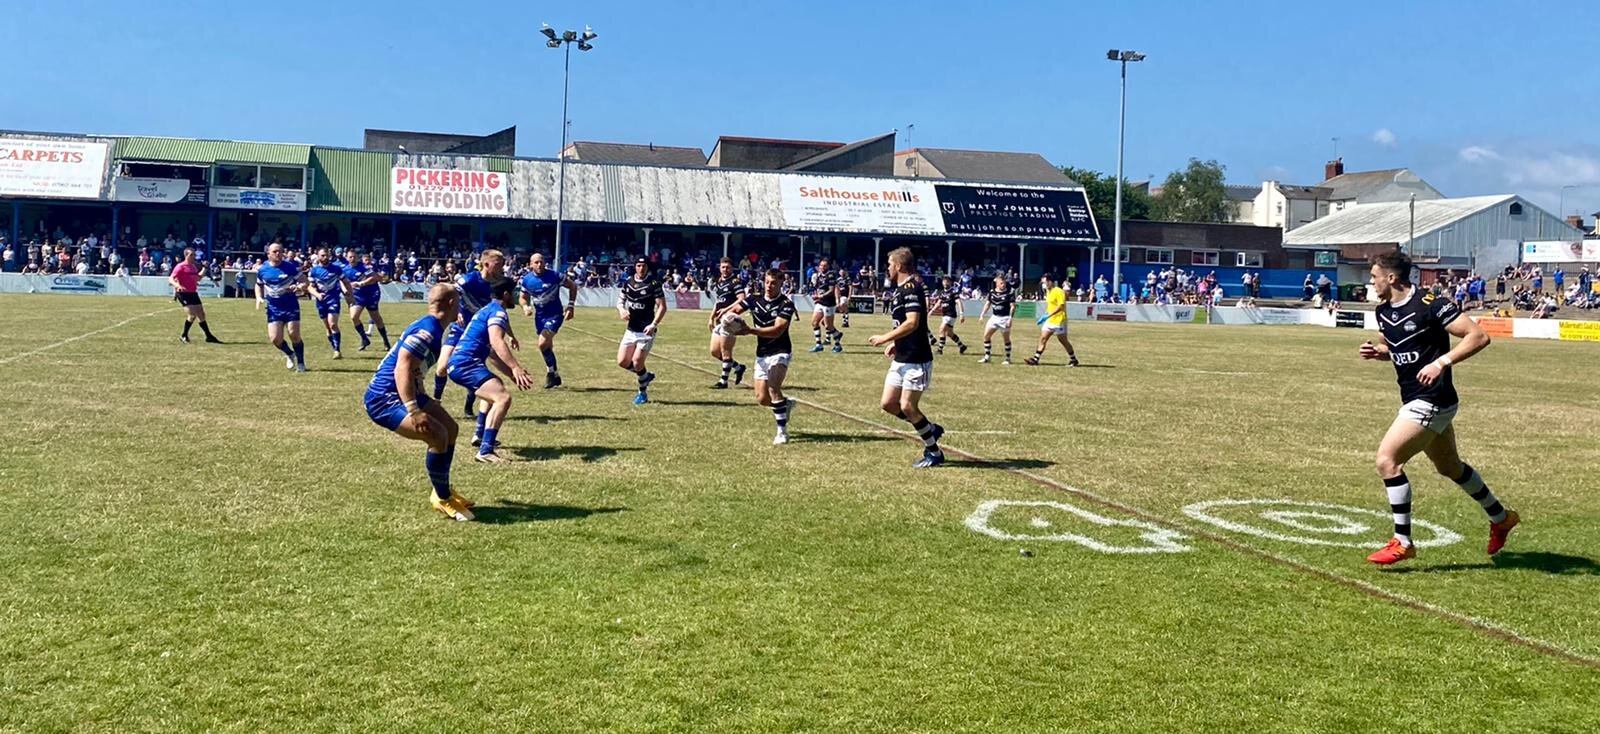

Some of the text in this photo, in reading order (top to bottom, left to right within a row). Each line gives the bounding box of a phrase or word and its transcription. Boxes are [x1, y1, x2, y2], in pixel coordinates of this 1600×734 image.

[0, 147, 84, 163] CARPETS
[396, 168, 500, 190] PICKERING
[395, 190, 505, 210] SCAFFOLDING
[799, 186, 920, 203] Salthouse Mills
[976, 189, 1018, 198] Welcome
[823, 200, 870, 208] INDUSTRIAL
[1003, 205, 1054, 213] JOHNSON
[951, 223, 1090, 235] mattjohnsonprestige.uk
[1390, 351, 1420, 366] QED
